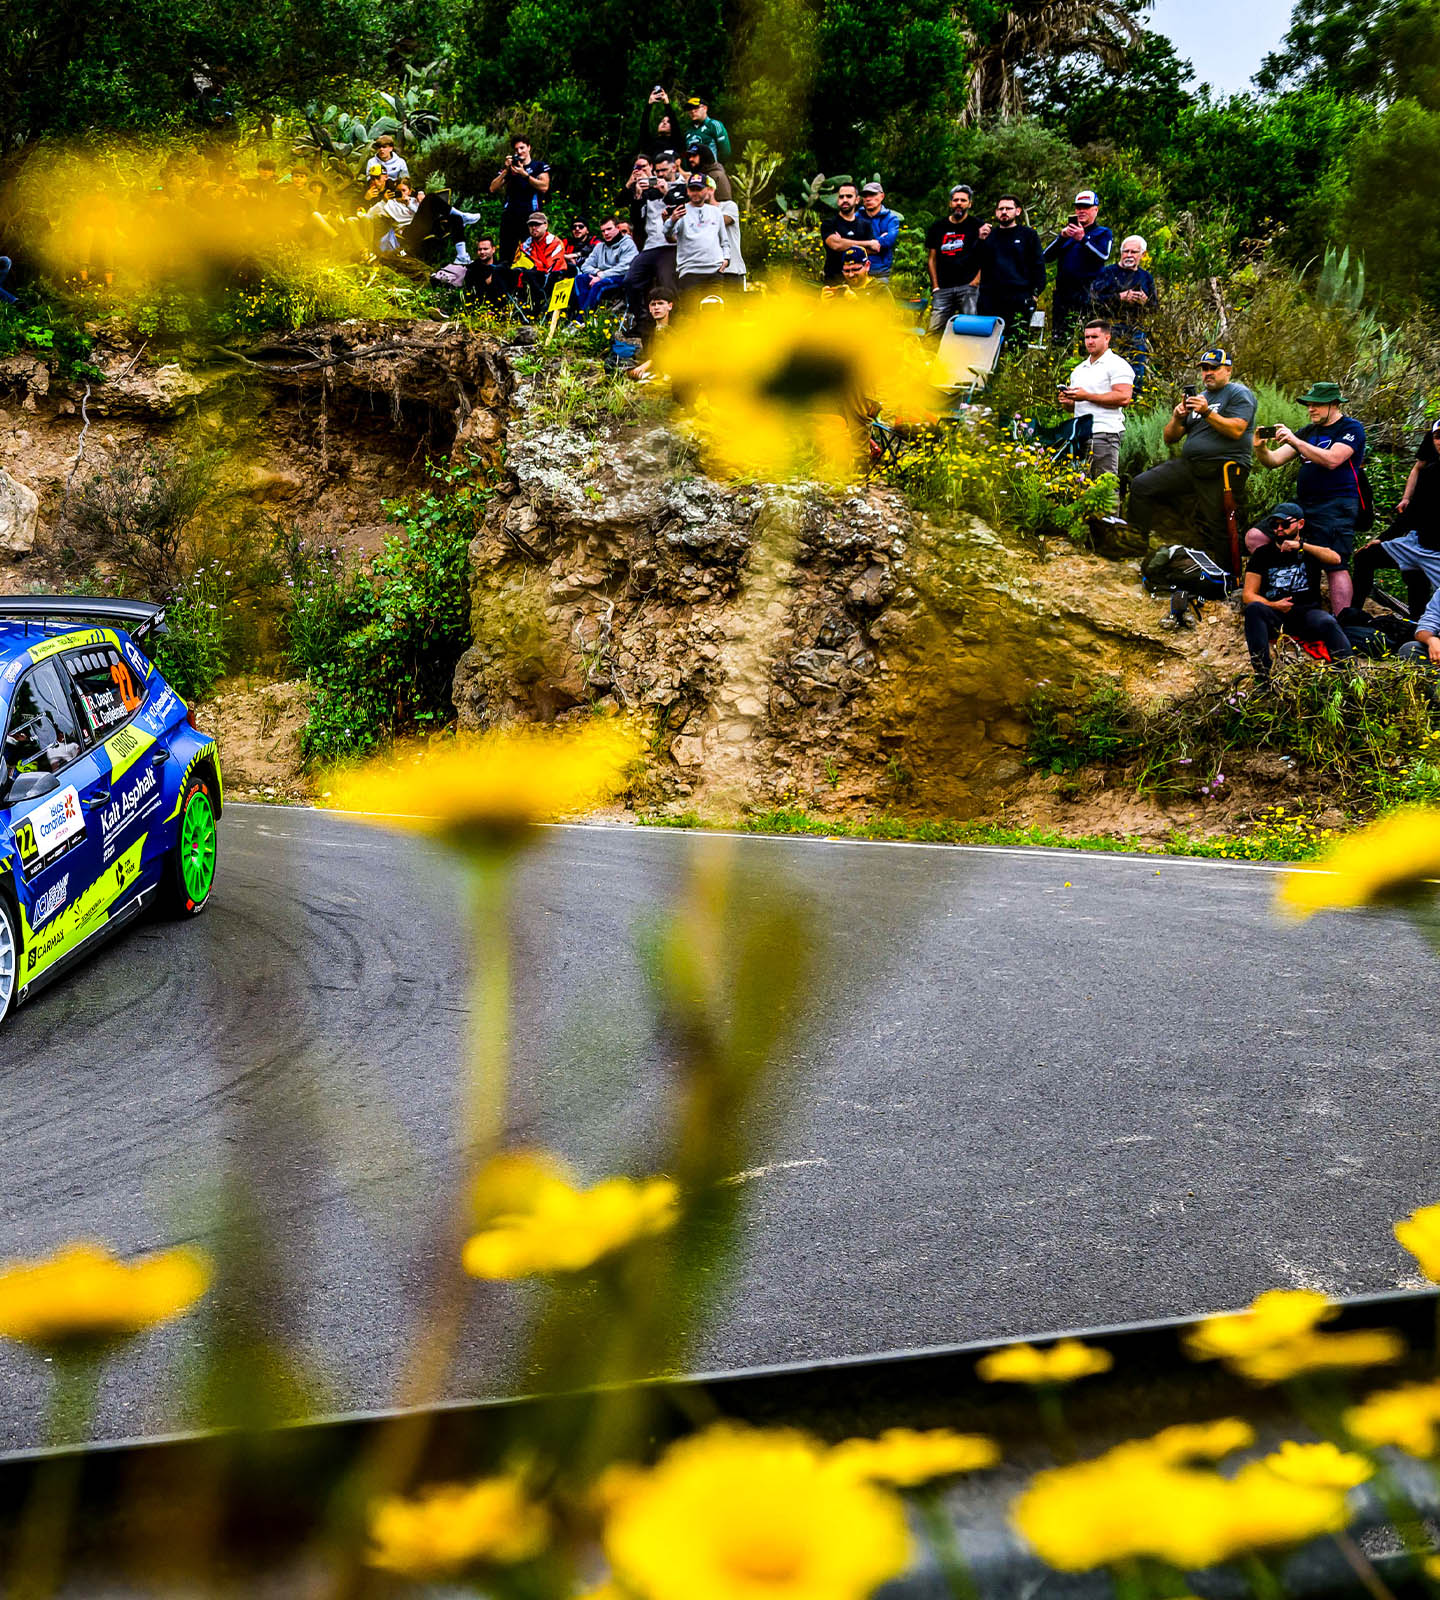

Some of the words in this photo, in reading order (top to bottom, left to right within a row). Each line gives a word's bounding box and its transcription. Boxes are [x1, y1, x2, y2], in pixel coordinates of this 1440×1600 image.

[110, 661, 142, 712] 22
[100, 801, 121, 835] Kalt
[121, 767, 156, 816] Asphalt
[16, 823, 38, 859] 22
[37, 929, 65, 959] CARMAX
